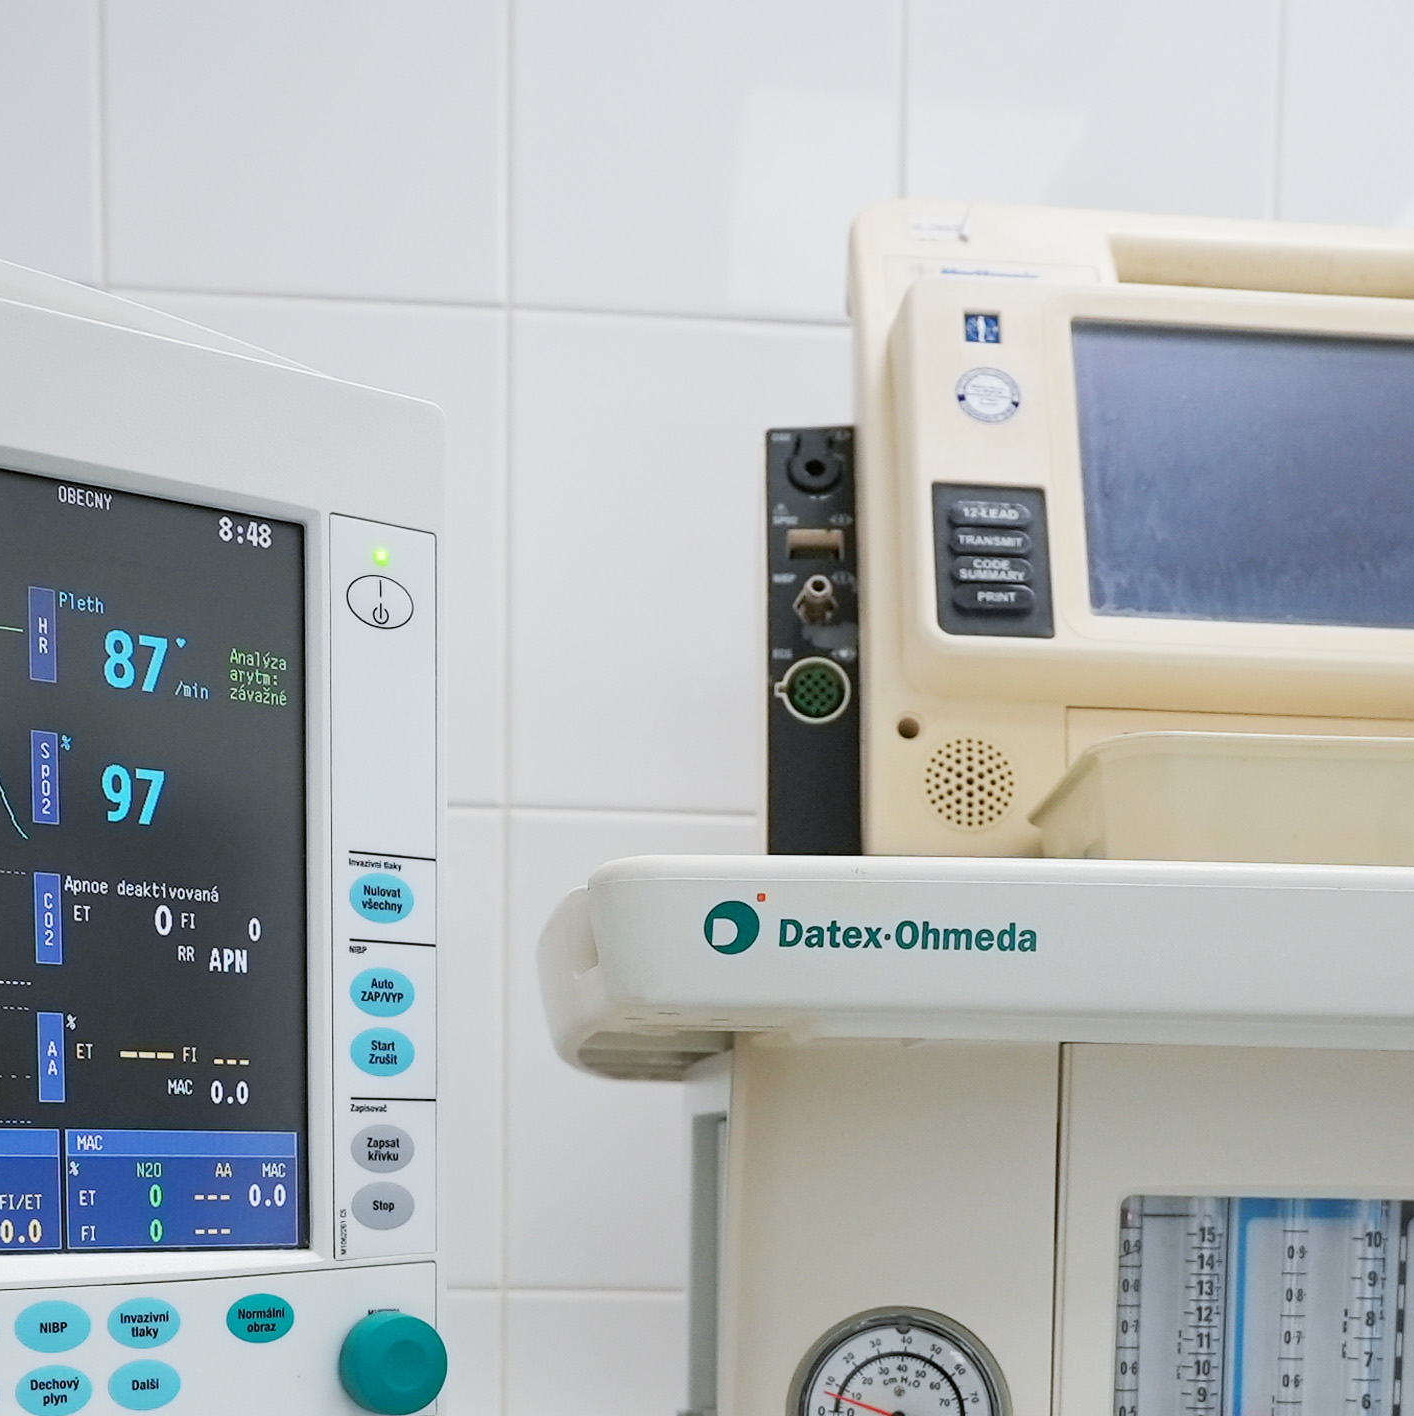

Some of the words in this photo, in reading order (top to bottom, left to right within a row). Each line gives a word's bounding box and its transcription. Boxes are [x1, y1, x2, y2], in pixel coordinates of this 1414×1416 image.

[58, 485, 112, 511] OBECNY
[963, 508, 1019, 520] 12-LEAD
[218, 516, 272, 548] 8:48
[58, 591, 105, 617] Pleth
[103, 629, 169, 696] 87
[173, 679, 209, 702] /min
[229, 647, 288, 672] Analýza
[228, 664, 279, 688] arytm:
[228, 680, 288, 708] závažné
[100, 762, 167, 827] 97
[64, 874, 109, 899] Apnoe
[117, 878, 220, 905] deaktivovaná
[364, 885, 401, 898] Nulovat
[73, 904, 91, 924] ET
[362, 898, 402, 914] všechny
[177, 944, 196, 964] RR
[209, 947, 249, 974] APN
[371, 976, 394, 991] Auto
[360, 989, 404, 1004] ZAP/VYP
[371, 1039, 396, 1053] Start
[369, 1051, 398, 1066] Zrušit
[167, 1077, 194, 1098] MAC
[210, 1080, 250, 1106] 0.0
[76, 1134, 104, 1152] MAC
[366, 1137, 400, 1150] Zapsat
[368, 1148, 399, 1163] křivku
[247, 1183, 287, 1208] 0.0
[372, 1198, 395, 1214] Stop
[0, 1219, 43, 1245] 0.0
[1199, 1227, 1216, 1243] 15
[1198, 1253, 1215, 1269] 14
[120, 1310, 170, 1326] Invazivní
[238, 1306, 285, 1321] Normální
[1196, 1306, 1213, 1322] 12
[39, 1320, 68, 1335] NIBP
[131, 1324, 160, 1340] tlaky
[247, 1320, 276, 1334] obraz
[30, 1376, 80, 1393] Dechový
[131, 1377, 160, 1392] Další
[42, 1391, 68, 1407] plyn
